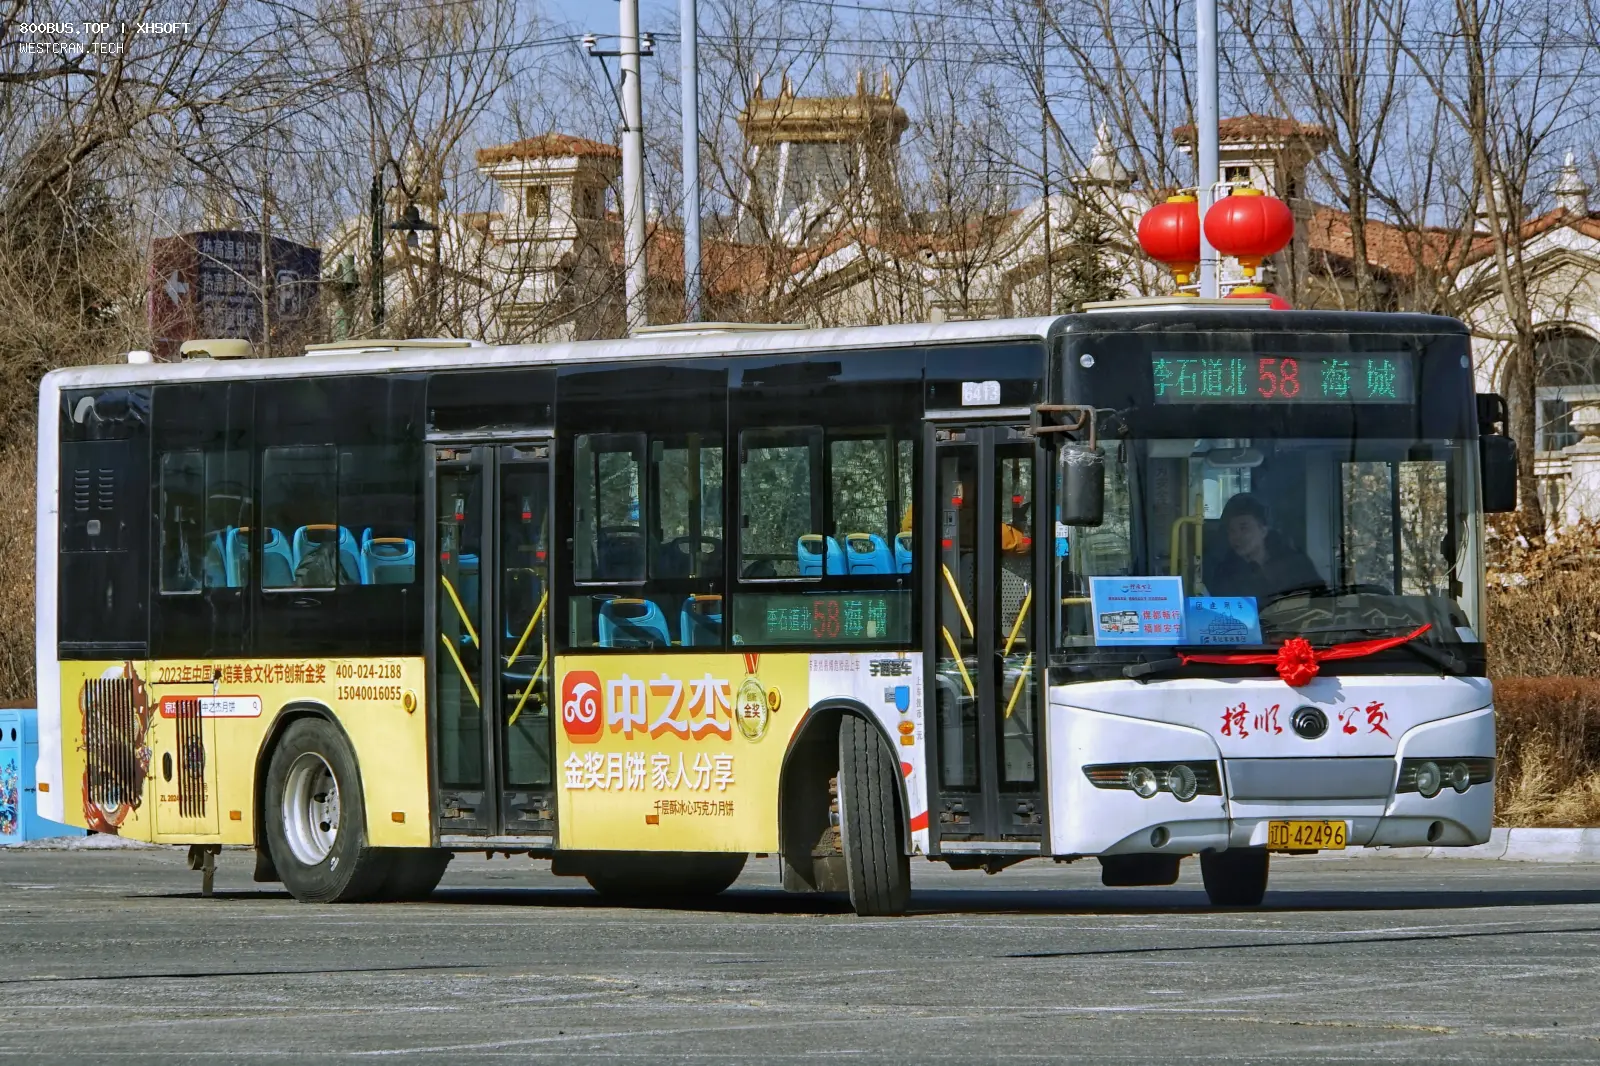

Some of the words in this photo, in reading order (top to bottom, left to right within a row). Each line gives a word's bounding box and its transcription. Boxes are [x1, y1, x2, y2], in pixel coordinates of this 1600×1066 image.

[1152, 358, 1247, 396] 李石道北
[1258, 357, 1300, 398] 58
[1321, 358, 1396, 398] 海城
[813, 600, 840, 638] 58
[335, 664, 402, 679] 400-024-2188
[338, 686, 401, 701] 15040016055
[606, 673, 733, 741] 中之杰
[743, 703, 761, 719] 金奖
[563, 751, 647, 791] 金奖月饼
[651, 751, 736, 792] 家人分享
[653, 799, 735, 817] 千层酥冰心巧克力月饼
